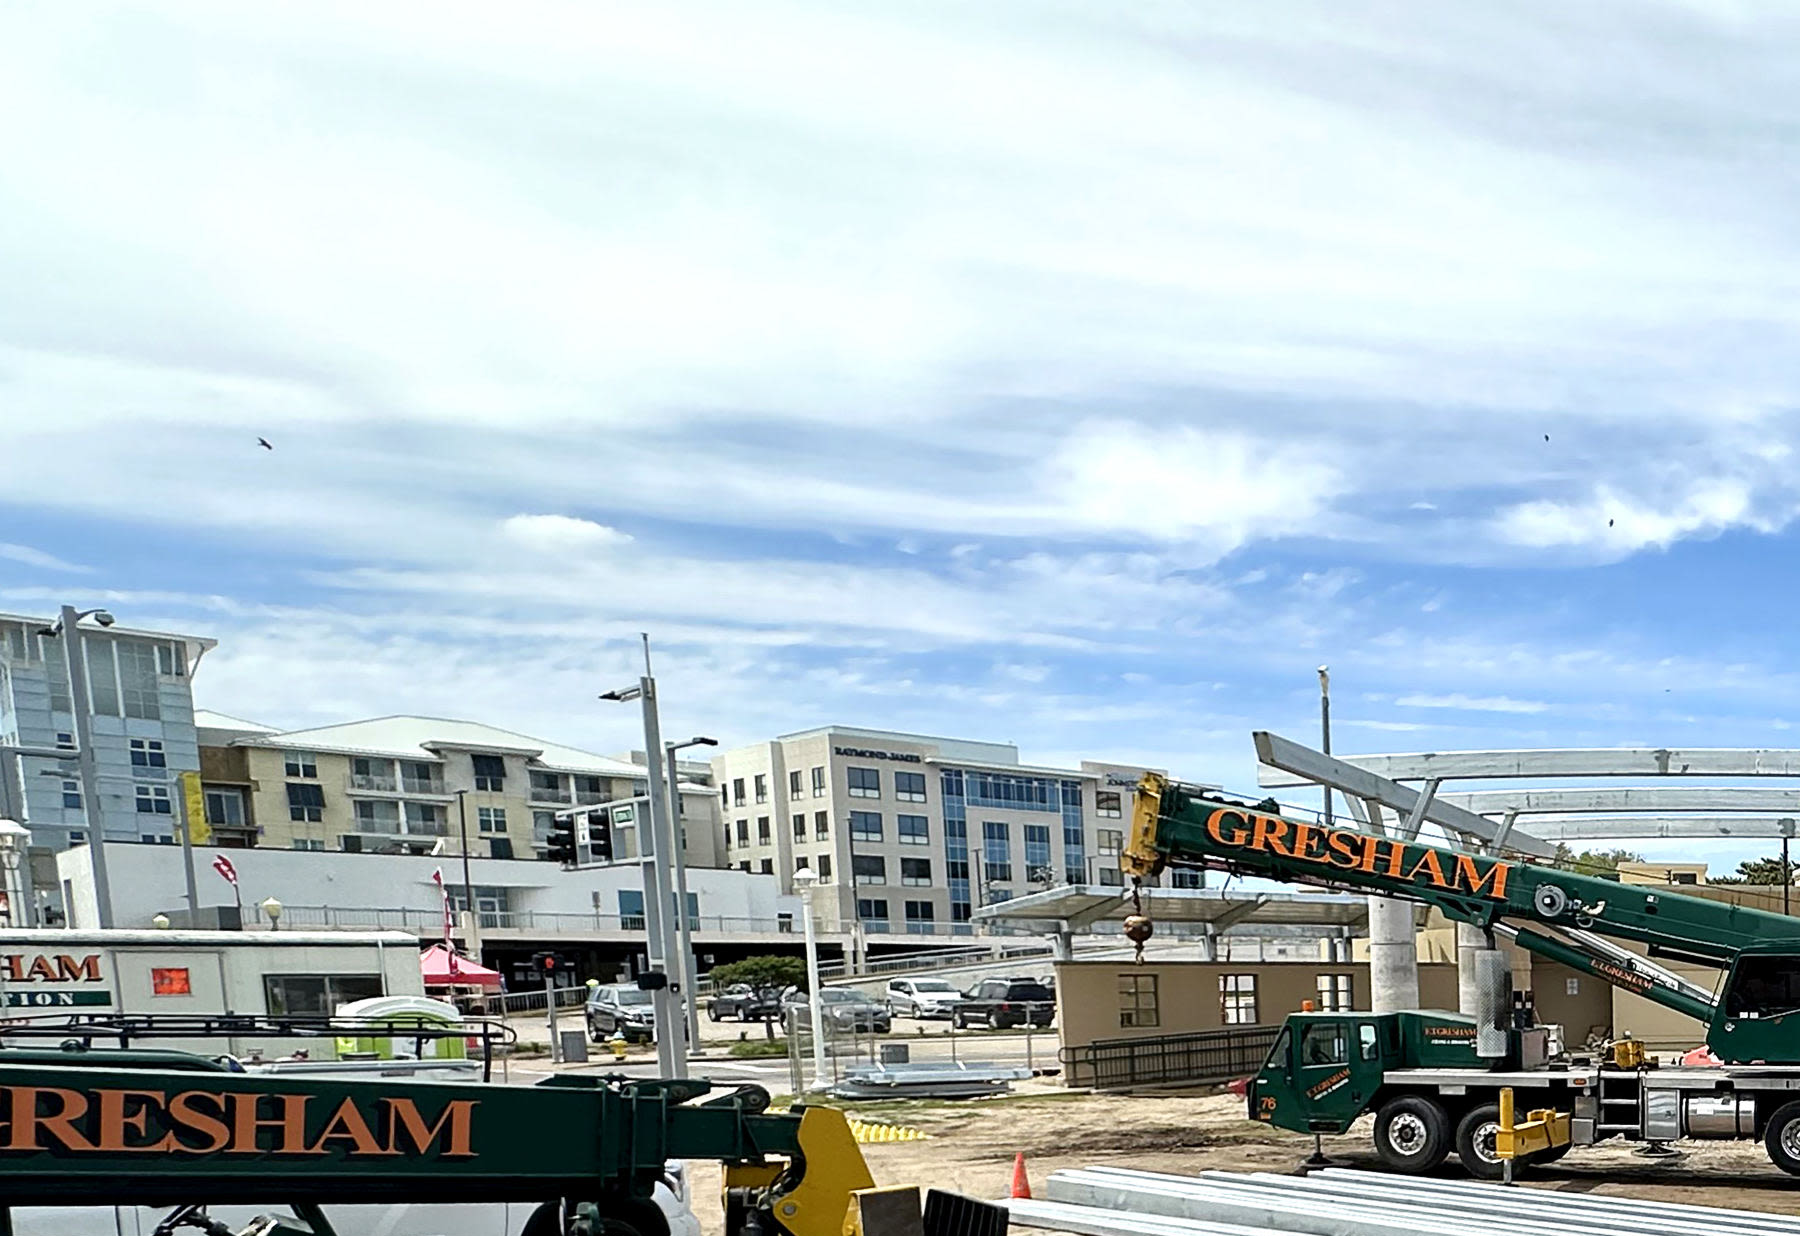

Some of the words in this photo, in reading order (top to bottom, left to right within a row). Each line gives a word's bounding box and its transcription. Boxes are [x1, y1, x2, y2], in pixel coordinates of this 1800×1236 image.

[1206, 807, 1513, 900] GRESHAM
[0, 1085, 481, 1156] RESHAM
[1260, 1096, 1276, 1110] 76
